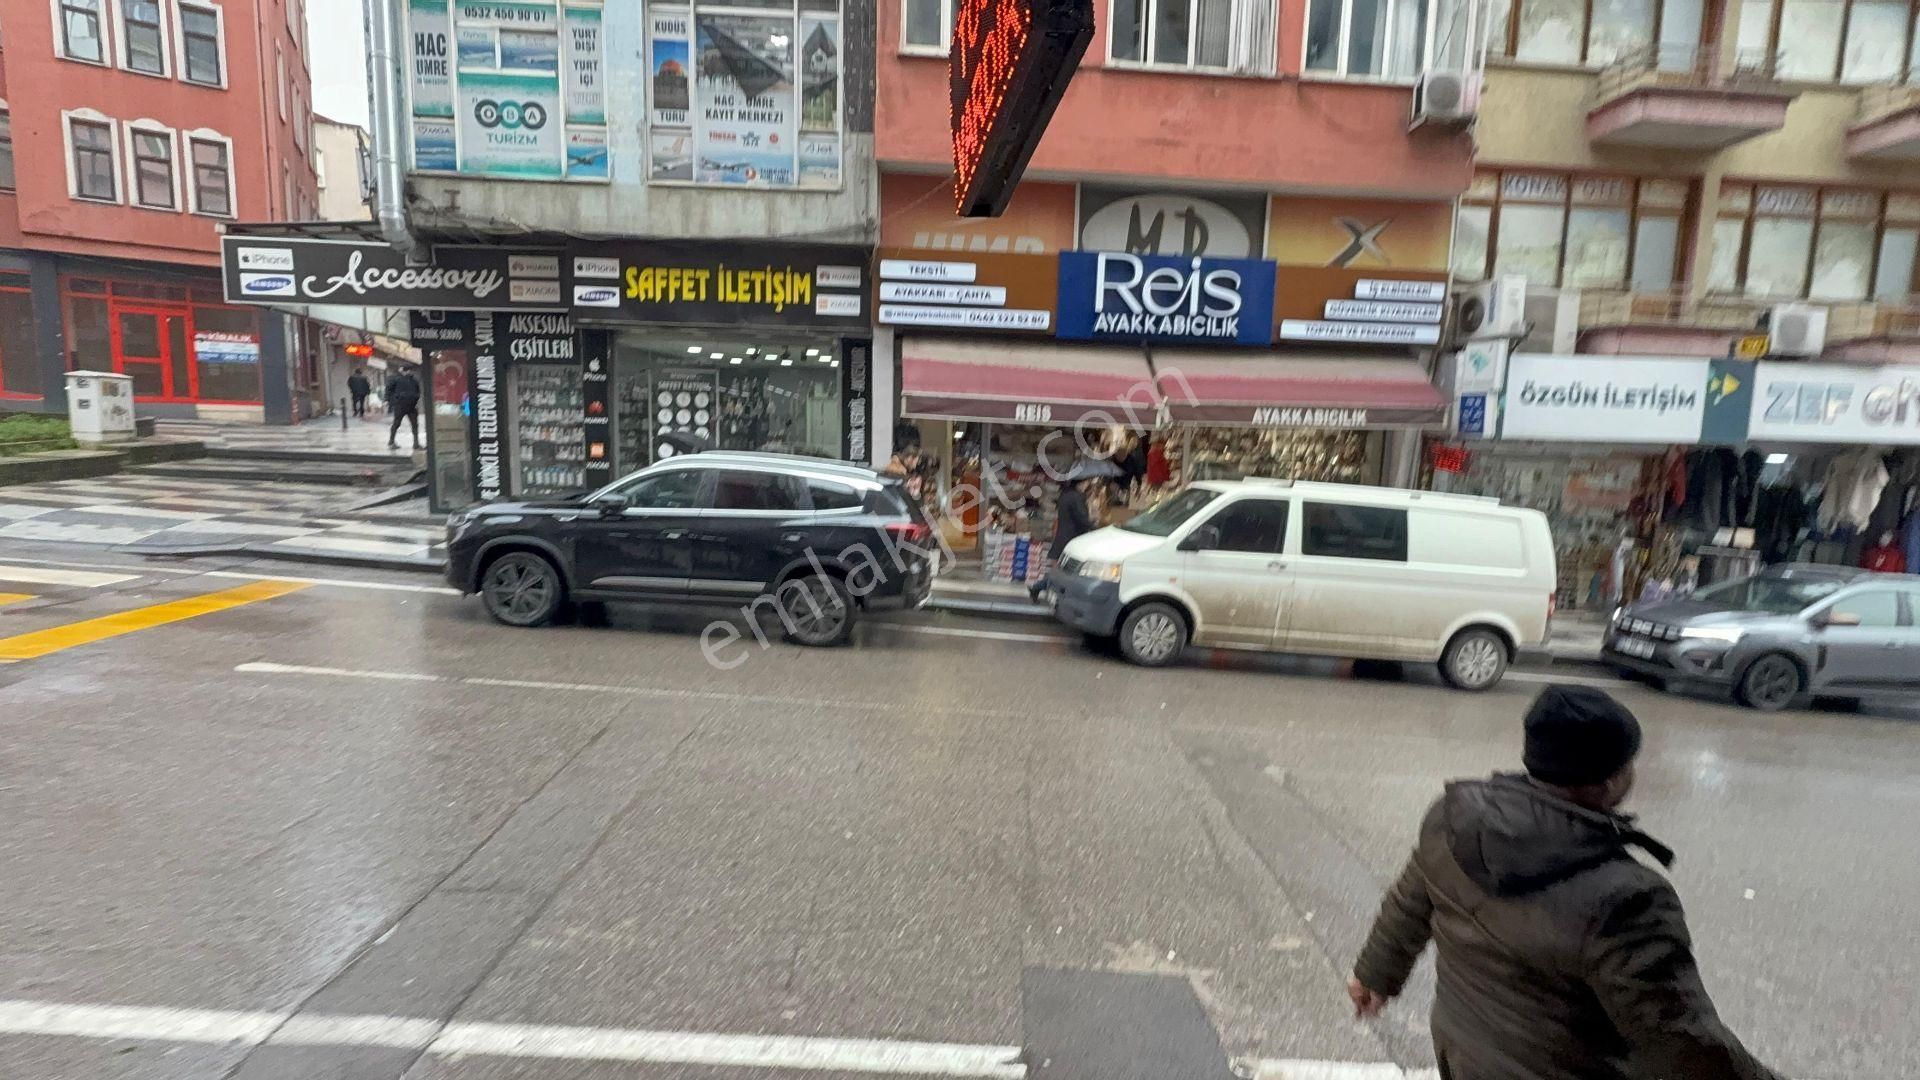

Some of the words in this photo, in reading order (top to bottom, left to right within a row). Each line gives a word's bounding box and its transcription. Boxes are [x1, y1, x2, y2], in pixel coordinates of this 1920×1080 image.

[464, 6, 491, 18] 0532
[495, 8, 514, 19] 450
[534, 10, 546, 22] 07
[414, 32, 447, 57] HAC
[572, 27, 597, 39] YURT
[573, 60, 598, 71] YURT
[714, 95, 735, 106] HAC
[705, 108, 735, 120] KAYIT
[486, 131, 538, 145] TURİZM
[252, 254, 290, 265] iPhone
[302, 250, 503, 298] Accessory
[1095, 252, 1242, 318] Reis
[625, 266, 710, 303] SAFFET
[718, 263, 812, 313] İLETİŞİM
[1094, 312, 1239, 337] AYAKKABICILIK
[509, 336, 574, 361] ÇEŞİTLERİ
[1520, 379, 1599, 408] ÖZGÜN
[1602, 381, 1697, 416] İLETİŞİM
[1763, 381, 1854, 424] ZEF
[477, 393, 498, 439] TELEFON
[1251, 407, 1369, 427] AYAKKABICILIK
